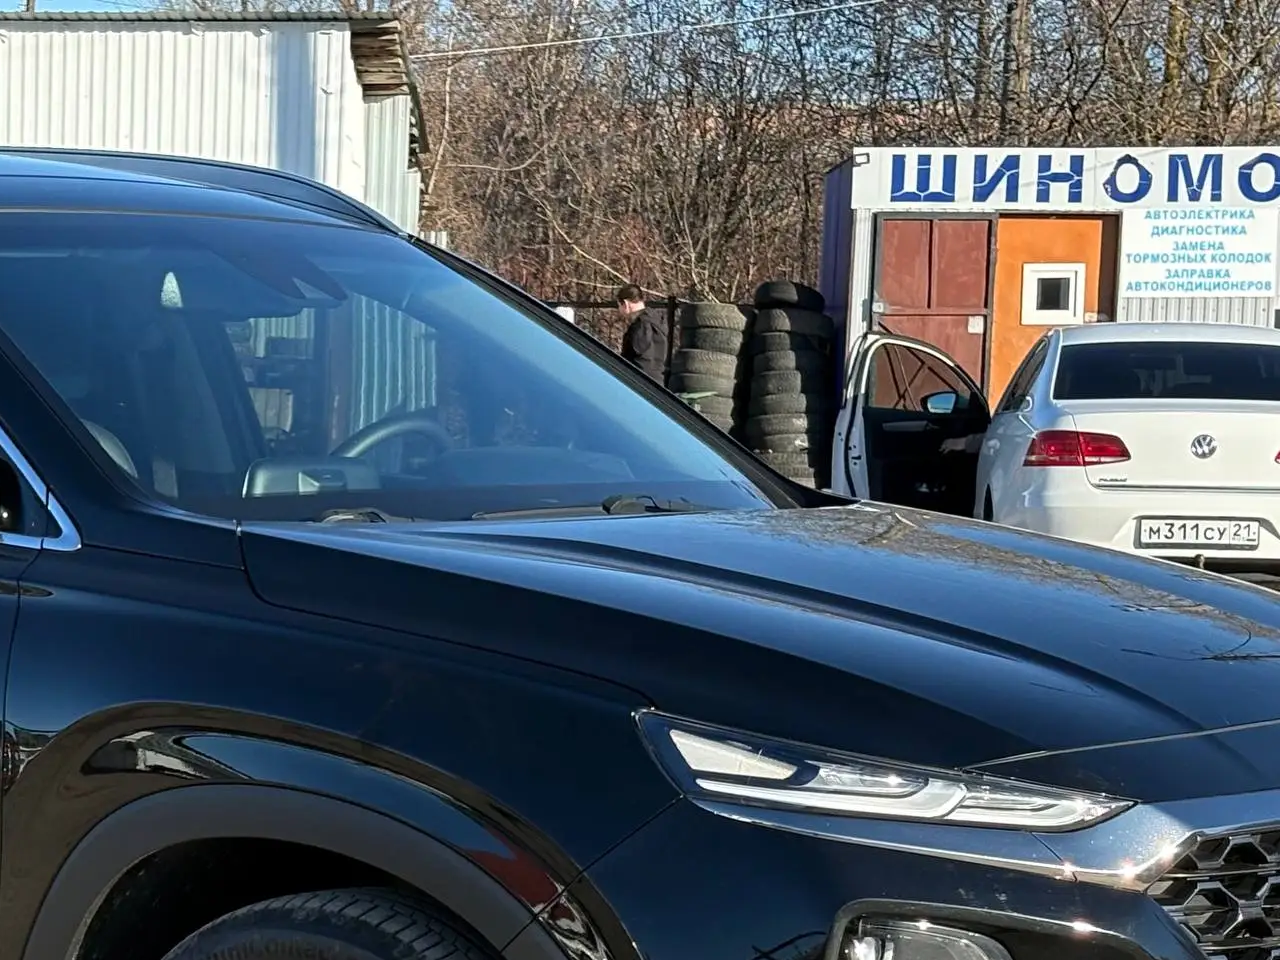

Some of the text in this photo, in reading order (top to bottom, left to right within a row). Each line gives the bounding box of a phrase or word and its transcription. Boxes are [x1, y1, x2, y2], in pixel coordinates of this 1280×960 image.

[1144, 209, 1255, 220] АВТОЭЛЕКТРИКА
[1151, 225, 1247, 237] ДИАГНОСТИКА
[1172, 241, 1225, 251] ЗАМЕНА
[1126, 253, 1272, 264] ТОРМОЗНЫХ КОЛОДОК
[1165, 268, 1231, 279] ЗАПРАВКА
[1125, 281, 1272, 293] АВТОКОНДИЦИОНЕРОВ
